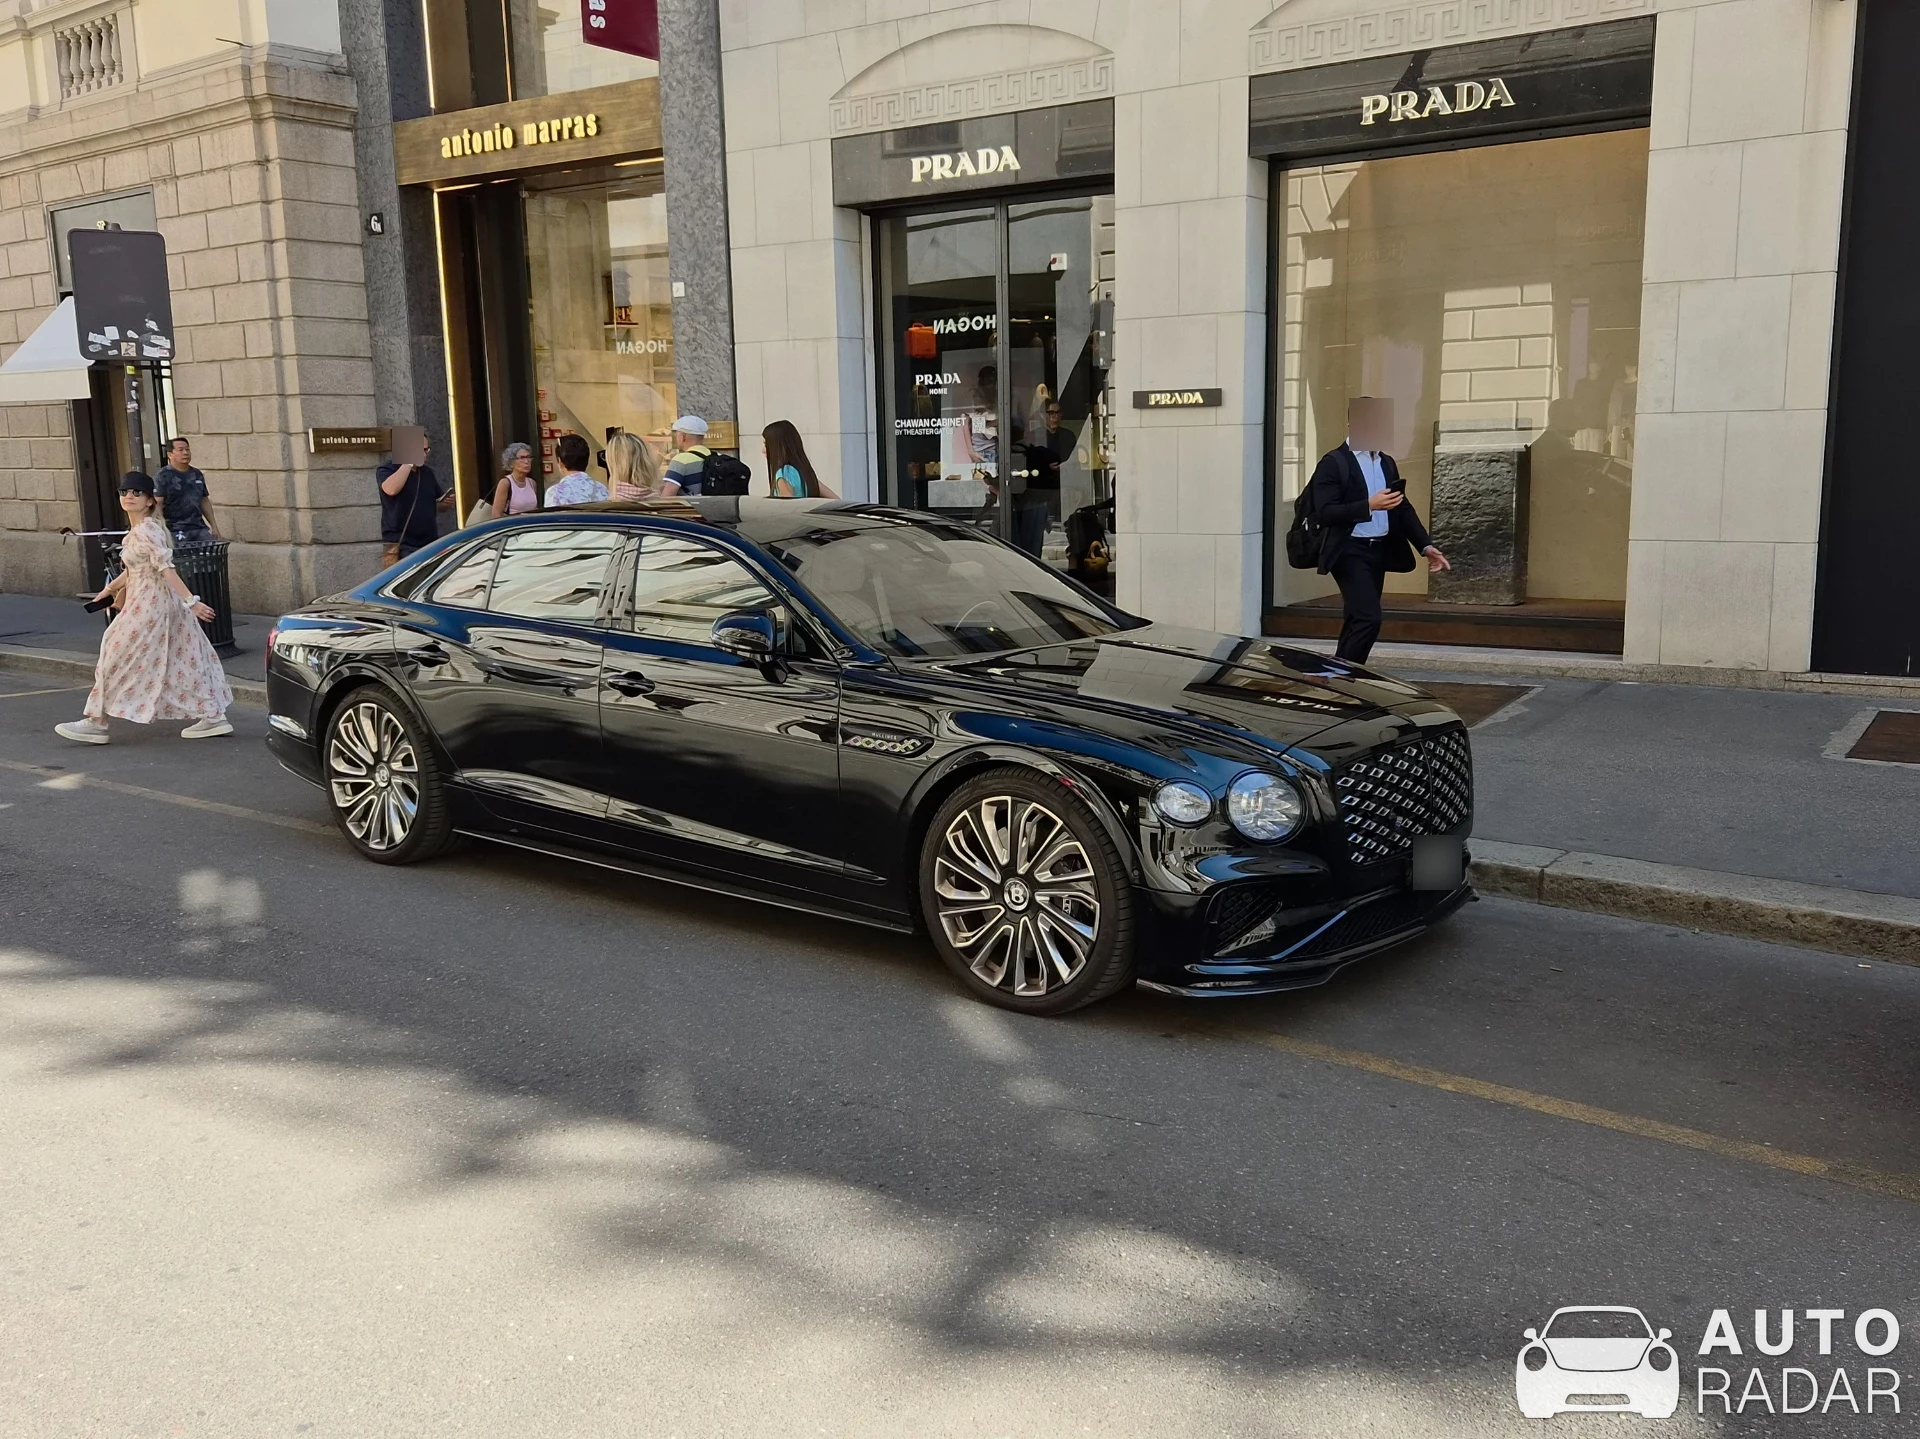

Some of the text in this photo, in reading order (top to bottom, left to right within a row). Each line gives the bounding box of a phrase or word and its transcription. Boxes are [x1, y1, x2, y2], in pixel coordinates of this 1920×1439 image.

[1360, 78, 1516, 125] PRADA
[441, 113, 598, 158] antonio marras
[910, 145, 1021, 182] PRADA
[915, 373, 961, 385] PRADA
[1148, 392, 1204, 405] PRADA
[895, 417, 966, 428] CHAWAN CABINET
[322, 436, 348, 444] antonio
